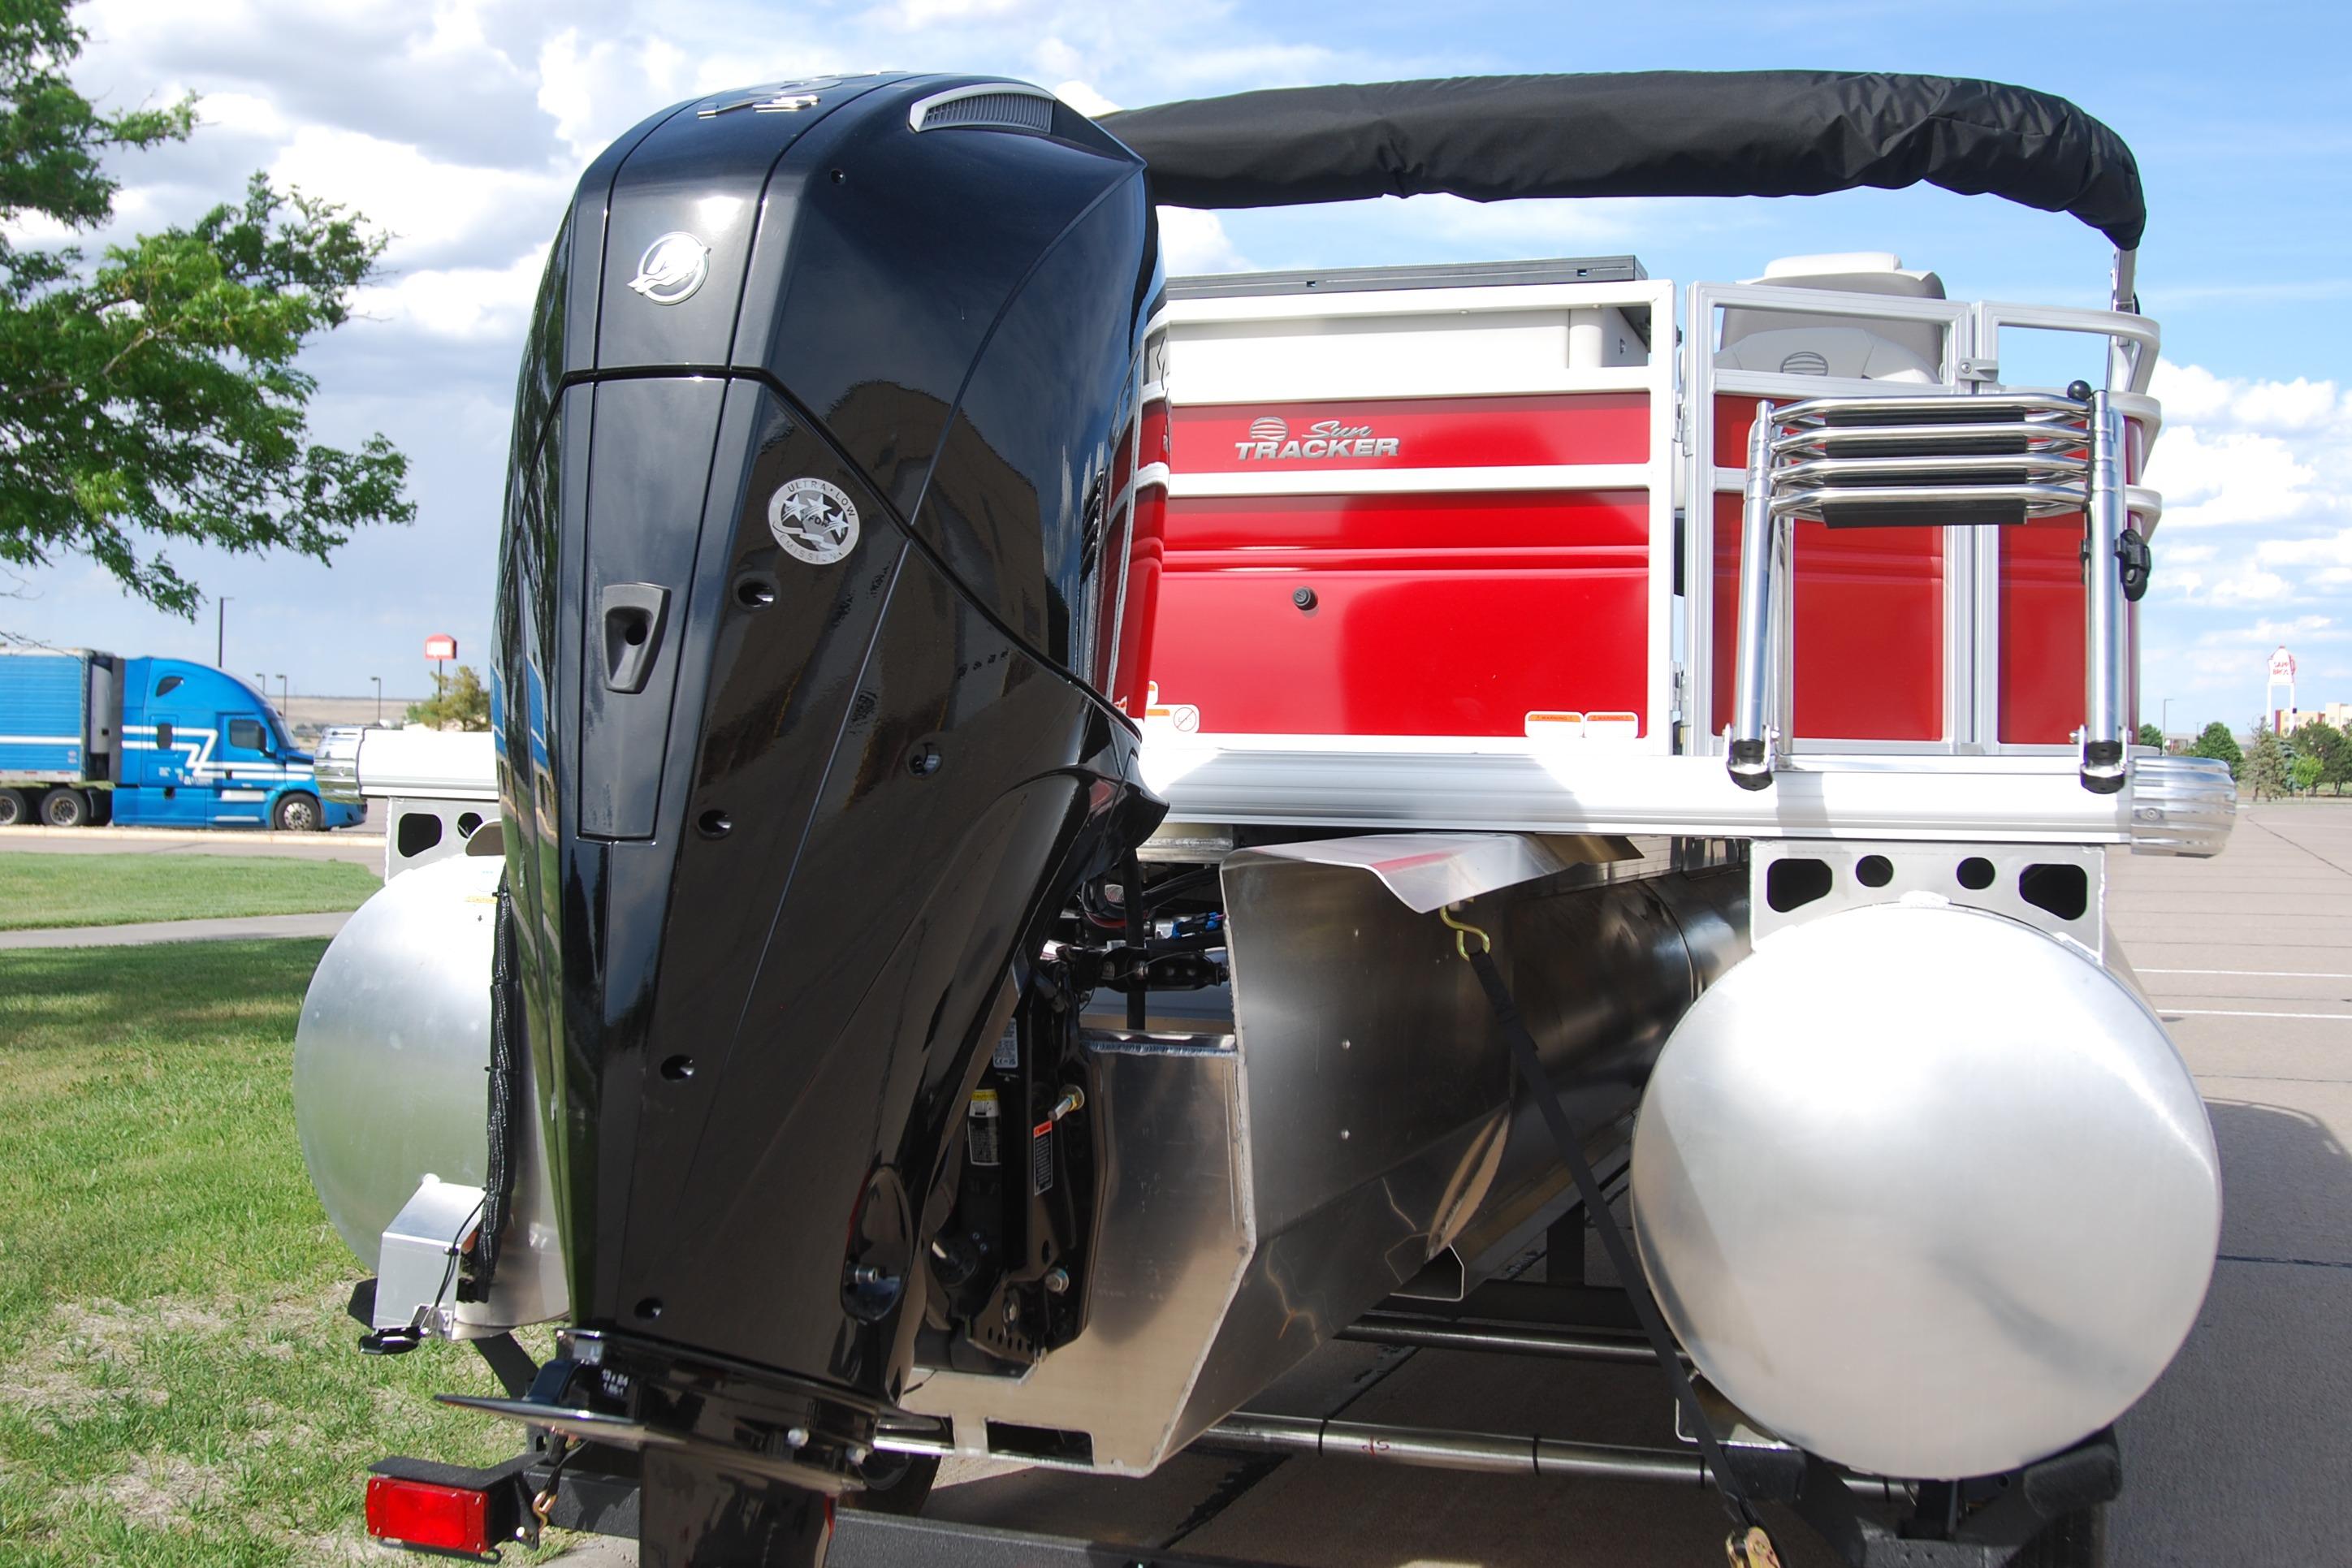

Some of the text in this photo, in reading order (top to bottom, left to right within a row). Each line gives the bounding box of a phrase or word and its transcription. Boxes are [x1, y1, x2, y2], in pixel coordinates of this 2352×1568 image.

[1302, 420, 1373, 439] Sun
[1234, 438, 1399, 460] TRACKER
[788, 480, 857, 517] ULTRA LOW
